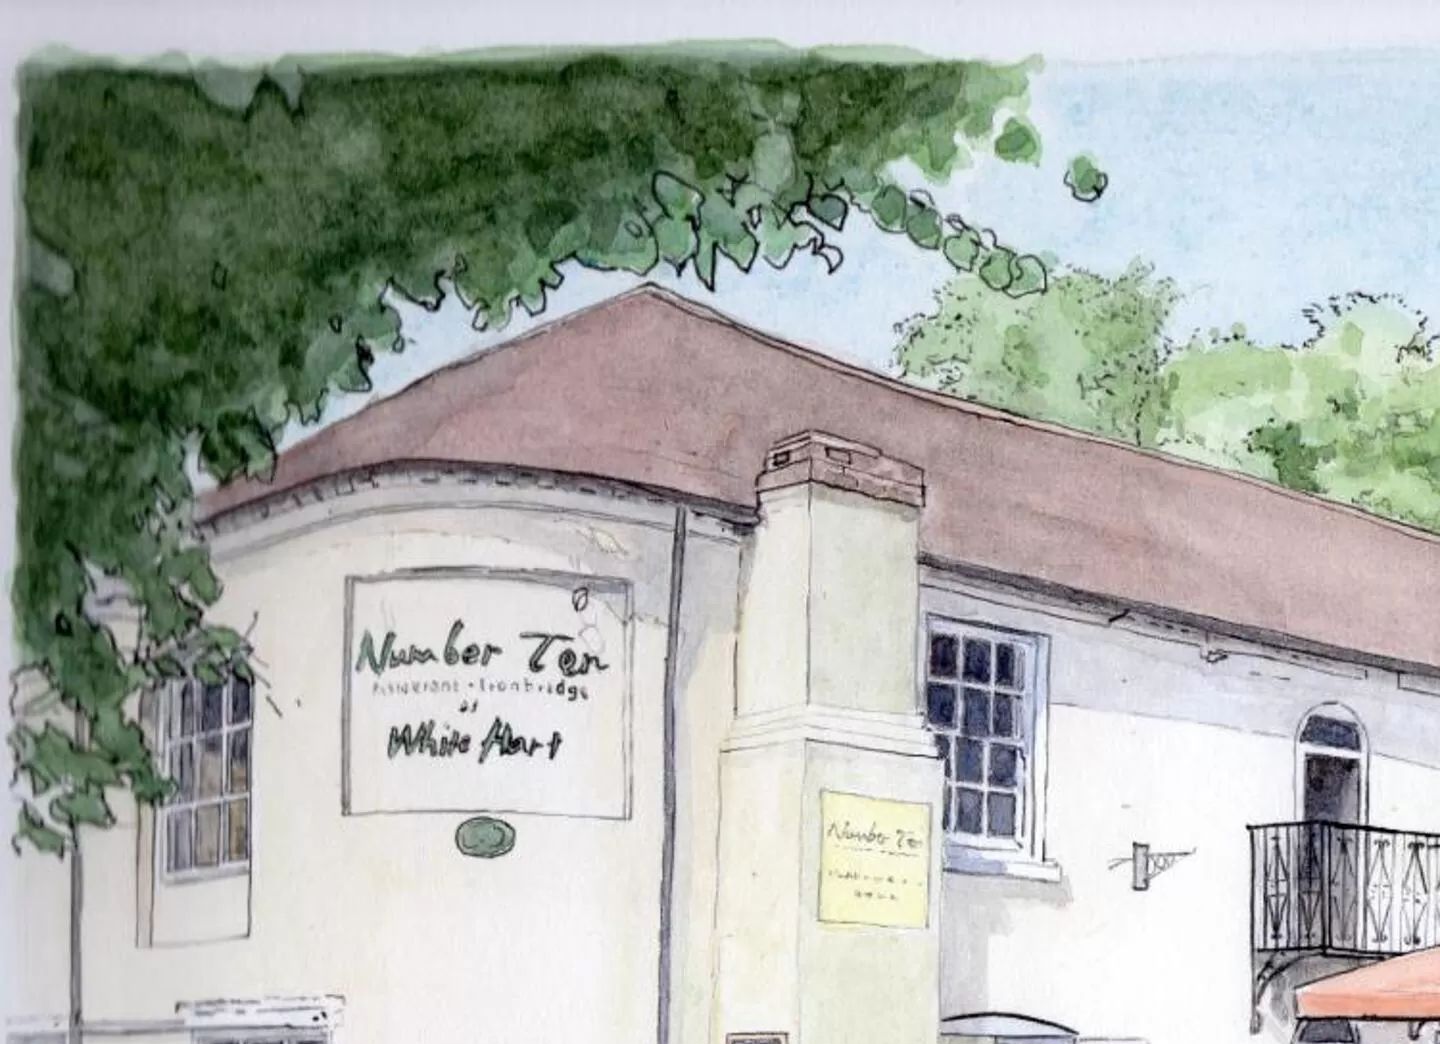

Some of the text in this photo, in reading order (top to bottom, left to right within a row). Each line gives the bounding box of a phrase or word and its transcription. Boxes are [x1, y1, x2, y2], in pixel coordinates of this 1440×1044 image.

[355, 618, 609, 677] Number Ten
[387, 718, 472, 760] White
